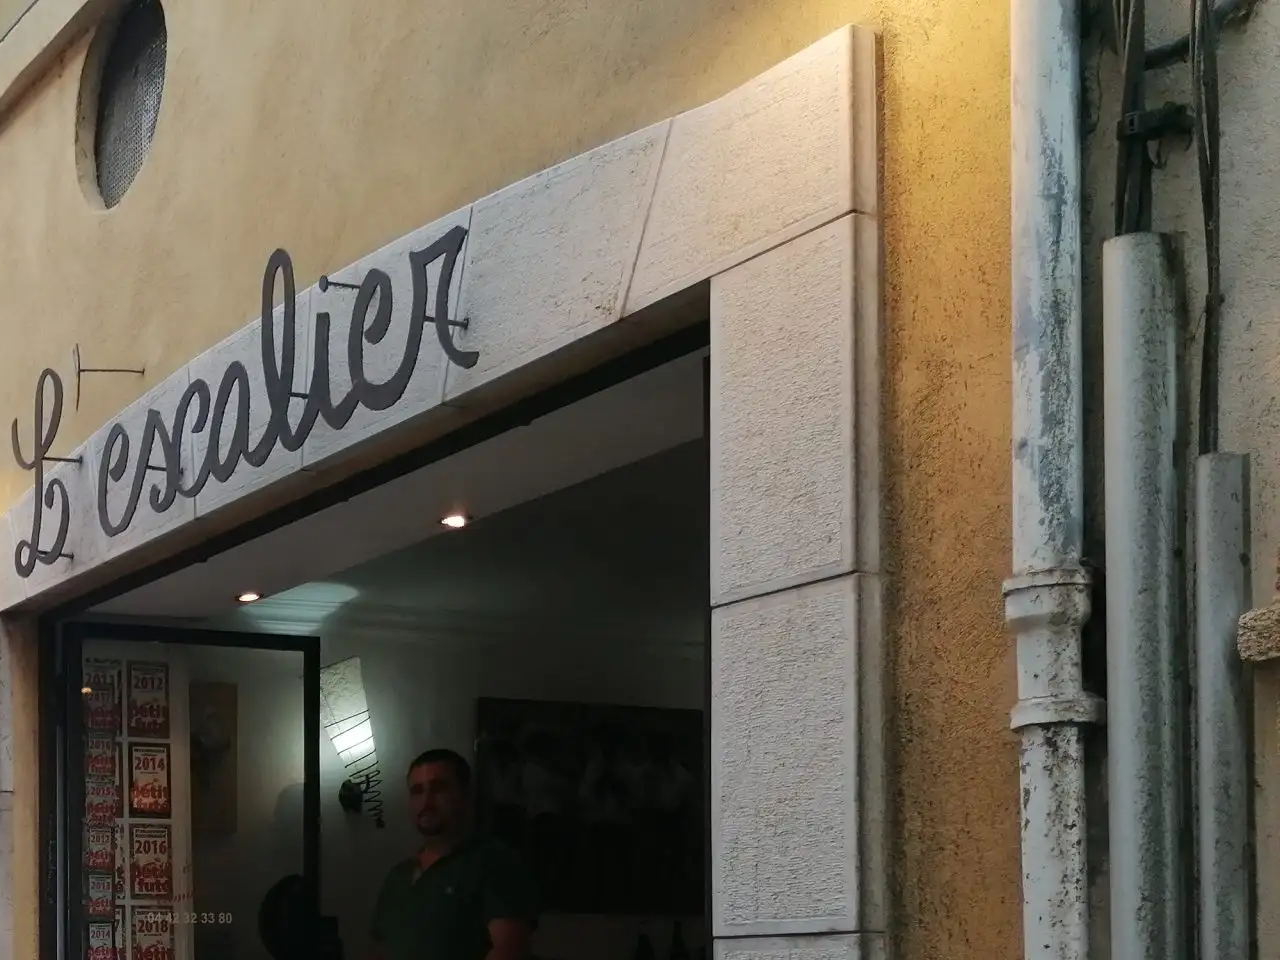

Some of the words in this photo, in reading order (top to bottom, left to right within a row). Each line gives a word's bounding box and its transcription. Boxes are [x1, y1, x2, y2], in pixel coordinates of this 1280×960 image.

[134, 676, 163, 690] 2012
[135, 757, 165, 771] 2014
[135, 840, 166, 854] 2016
[165, 912, 180, 924] 42
[183, 912, 197, 924] 32
[200, 912, 215, 924] 33
[218, 912, 233, 924] 80
[137, 919, 169, 933] 2018
[91, 930, 111, 939] 2014
